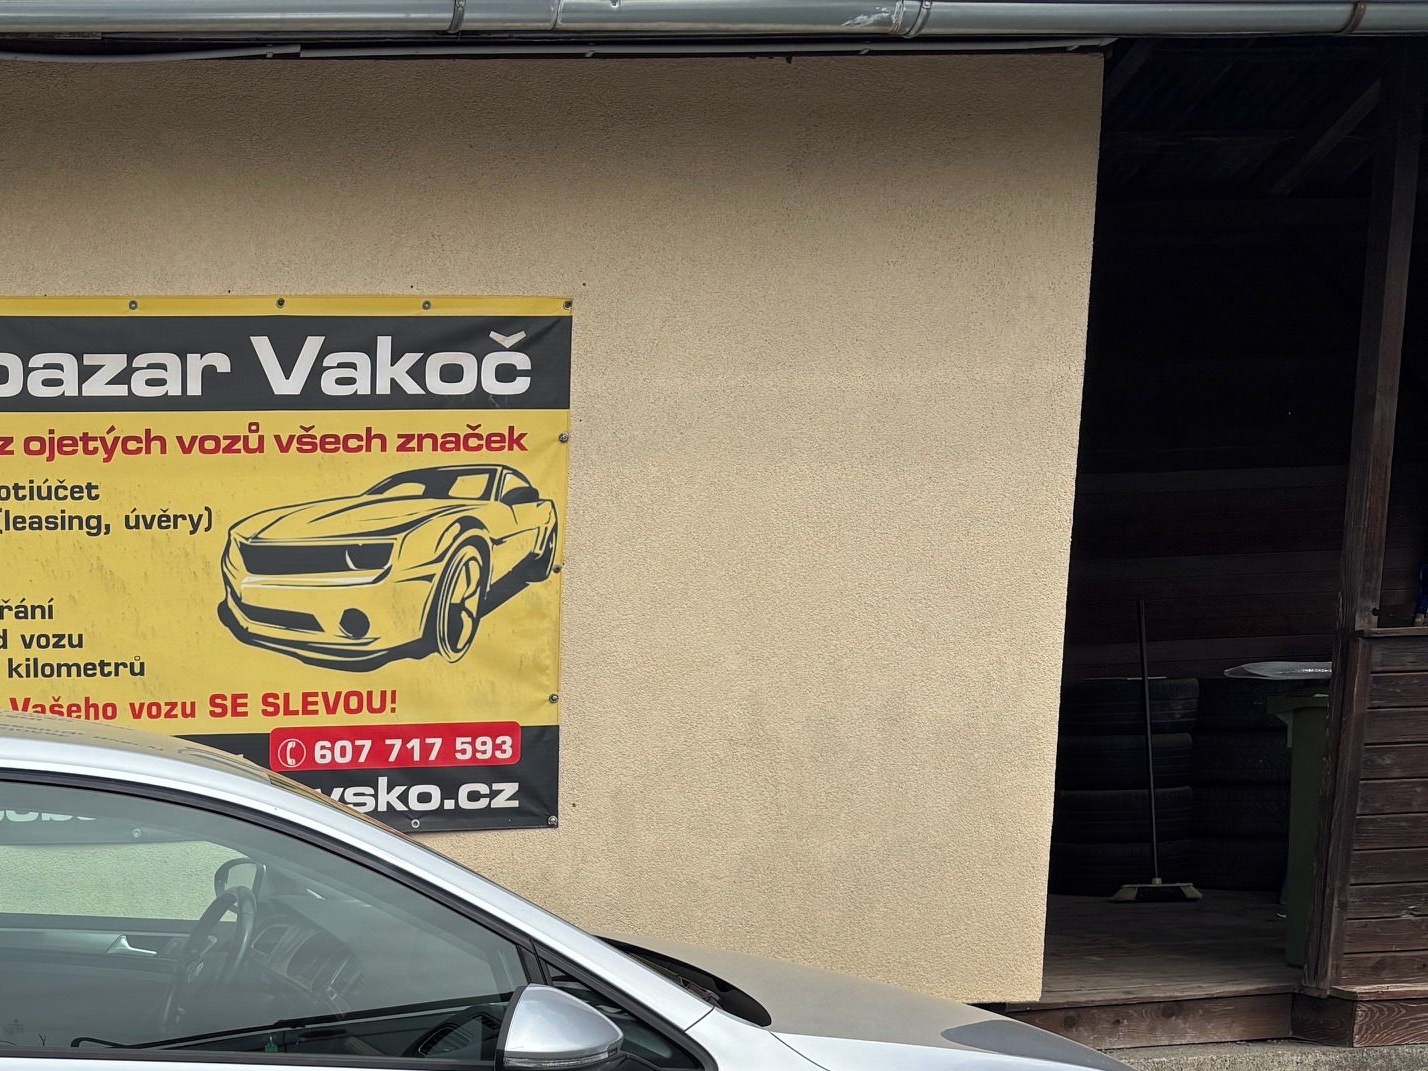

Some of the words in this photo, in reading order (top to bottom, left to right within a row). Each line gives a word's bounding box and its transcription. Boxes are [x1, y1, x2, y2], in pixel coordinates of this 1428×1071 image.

[250, 331, 531, 395] Vakoč
[23, 425, 167, 463] ojetých
[177, 422, 264, 455] vozů
[275, 425, 387, 454] všech
[396, 424, 527, 452] značek
[125, 506, 212, 535] úvěry)
[21, 633, 83, 649] vozu
[8, 656, 145, 679] kilometrů
[129, 699, 196, 720] vozu
[209, 693, 248, 718] SE
[261, 690, 397, 717] SLEVOU!
[314, 739, 372, 764] 607
[385, 738, 443, 761] 717
[455, 736, 513, 760] 593
